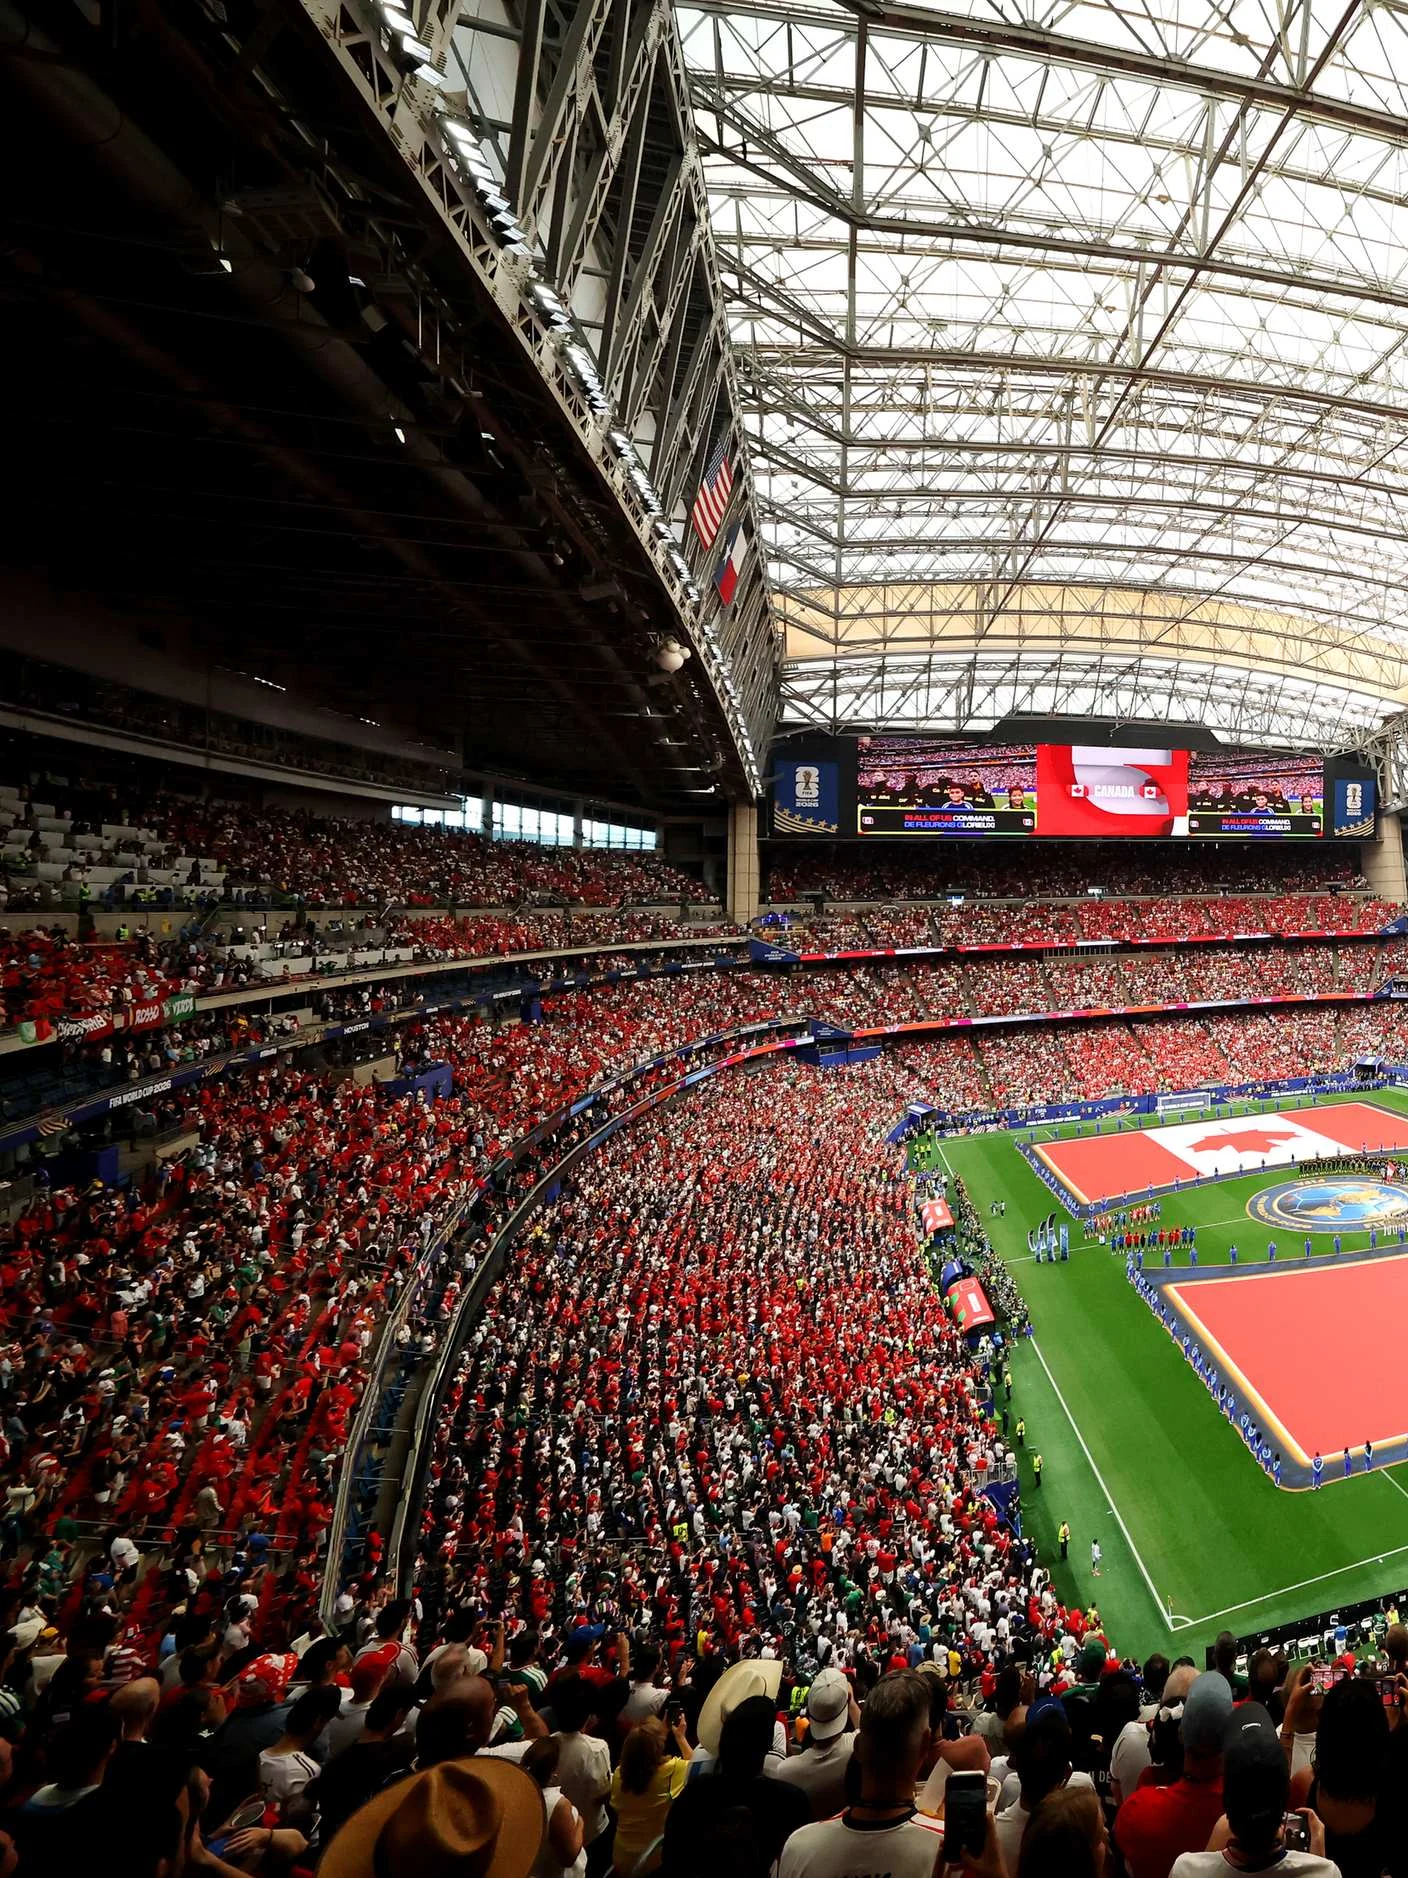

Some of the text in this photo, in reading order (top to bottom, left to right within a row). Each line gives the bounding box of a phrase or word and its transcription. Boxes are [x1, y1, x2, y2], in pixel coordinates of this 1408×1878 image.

[1094, 785, 1135, 798] CANADA
[343, 1022, 370, 1035] HOUSTON
[153, 1080, 172, 1094] 2026
